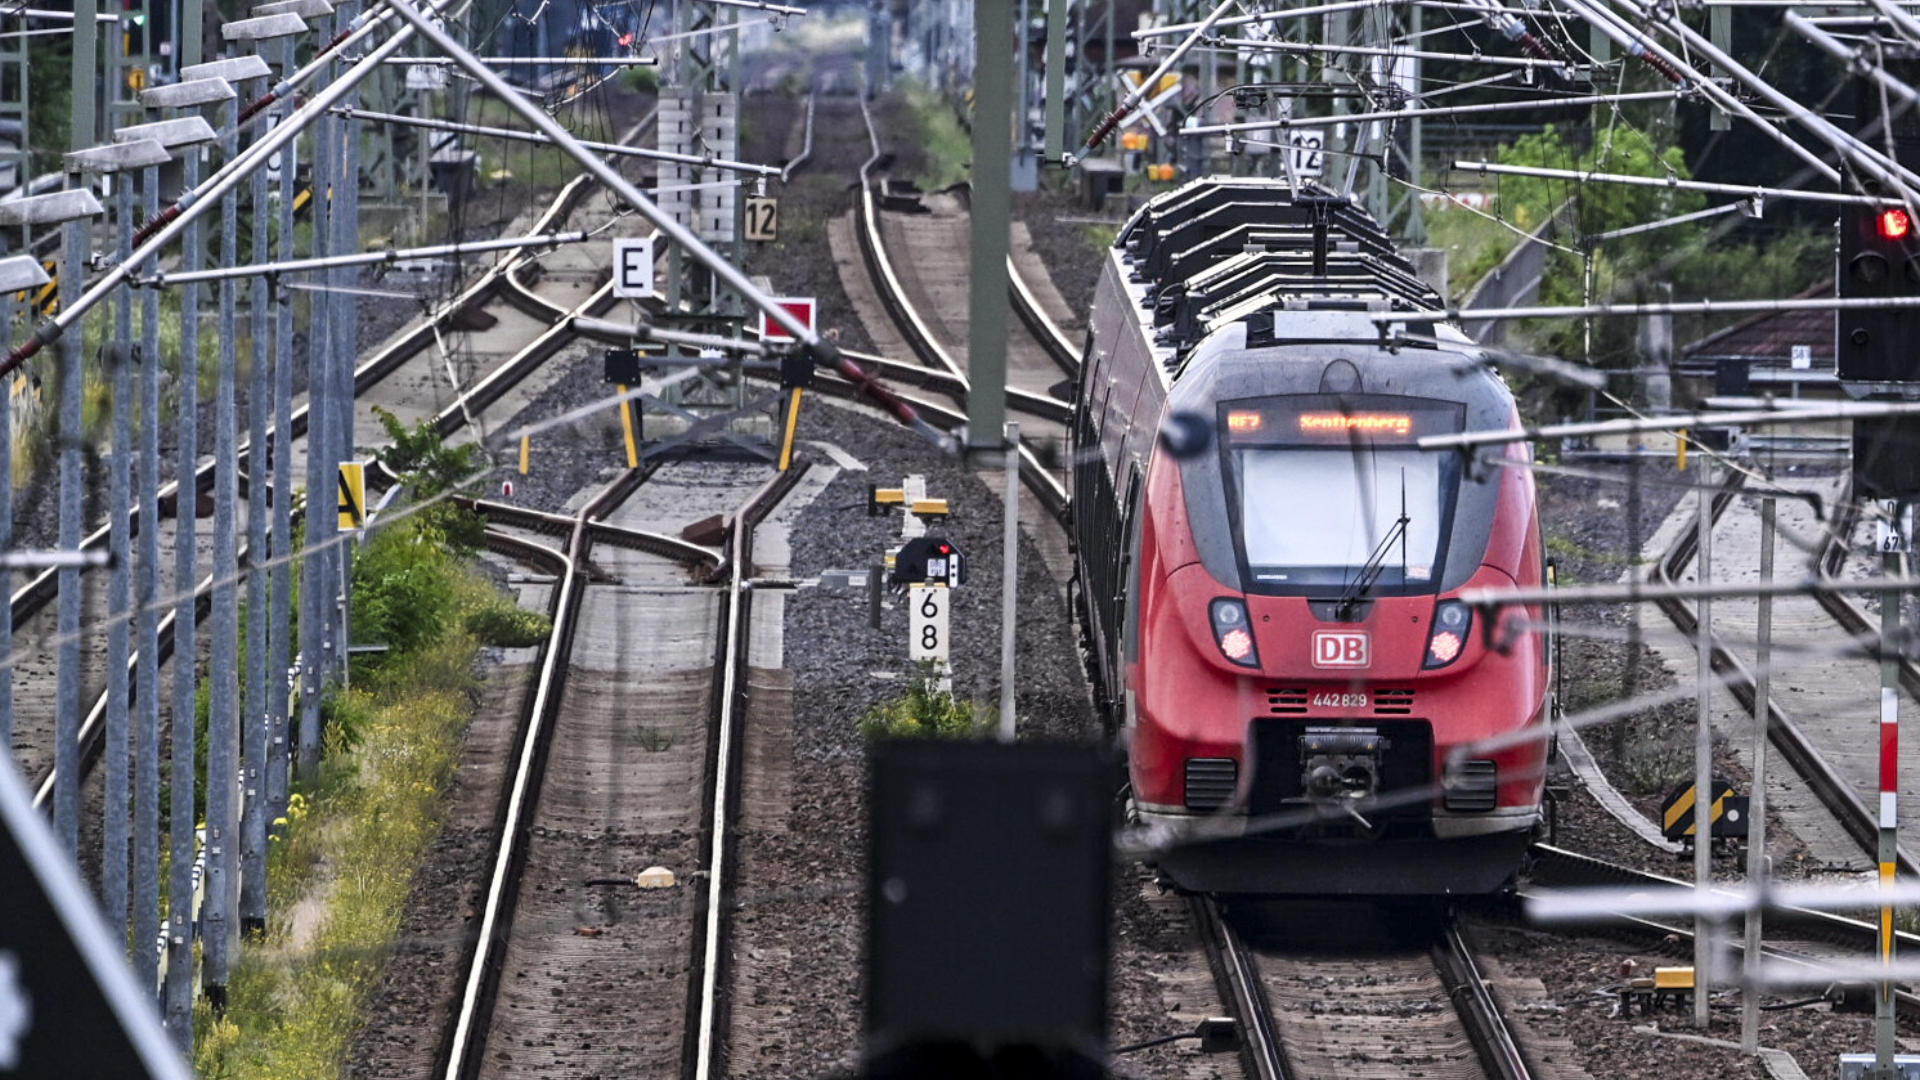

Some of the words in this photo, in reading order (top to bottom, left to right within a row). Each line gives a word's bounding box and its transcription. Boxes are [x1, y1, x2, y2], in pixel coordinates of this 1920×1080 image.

[1292, 137, 1320, 169] 12
[747, 203, 775, 236] 12
[622, 247, 644, 289] E
[1320, 637, 1363, 661] DB
